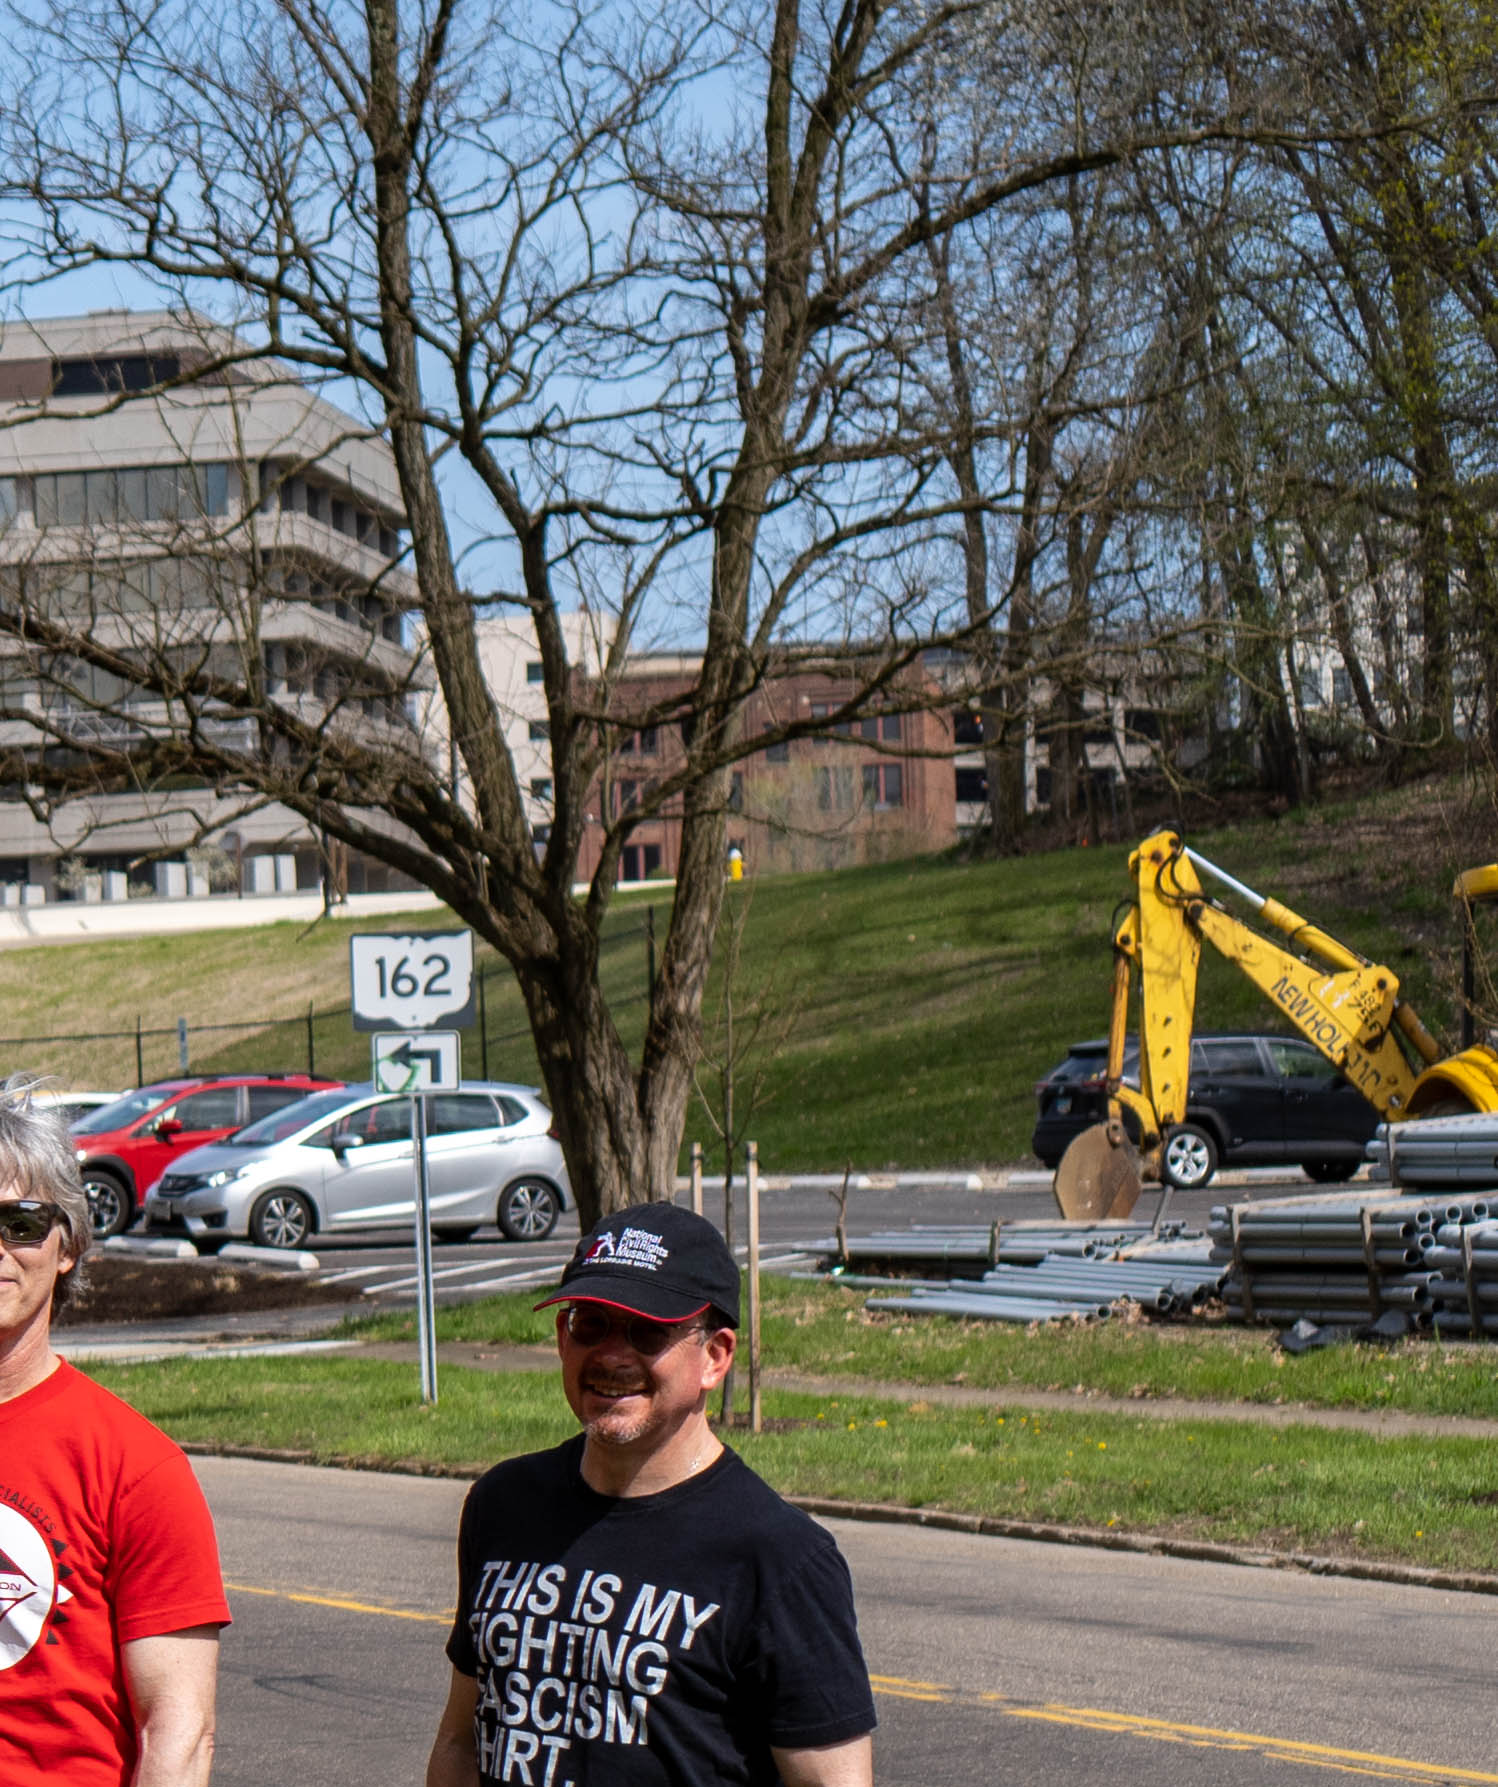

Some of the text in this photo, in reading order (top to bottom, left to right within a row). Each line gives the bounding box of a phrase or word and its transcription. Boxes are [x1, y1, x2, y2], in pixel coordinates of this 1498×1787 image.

[375, 953, 452, 999] 162
[1271, 976, 1313, 1018] NEW
[619, 1237, 669, 1258] Civil Rights
[623, 1227, 663, 1244] National
[615, 1246, 657, 1263] Museum
[474, 1560, 720, 1650] THIS IS MY
